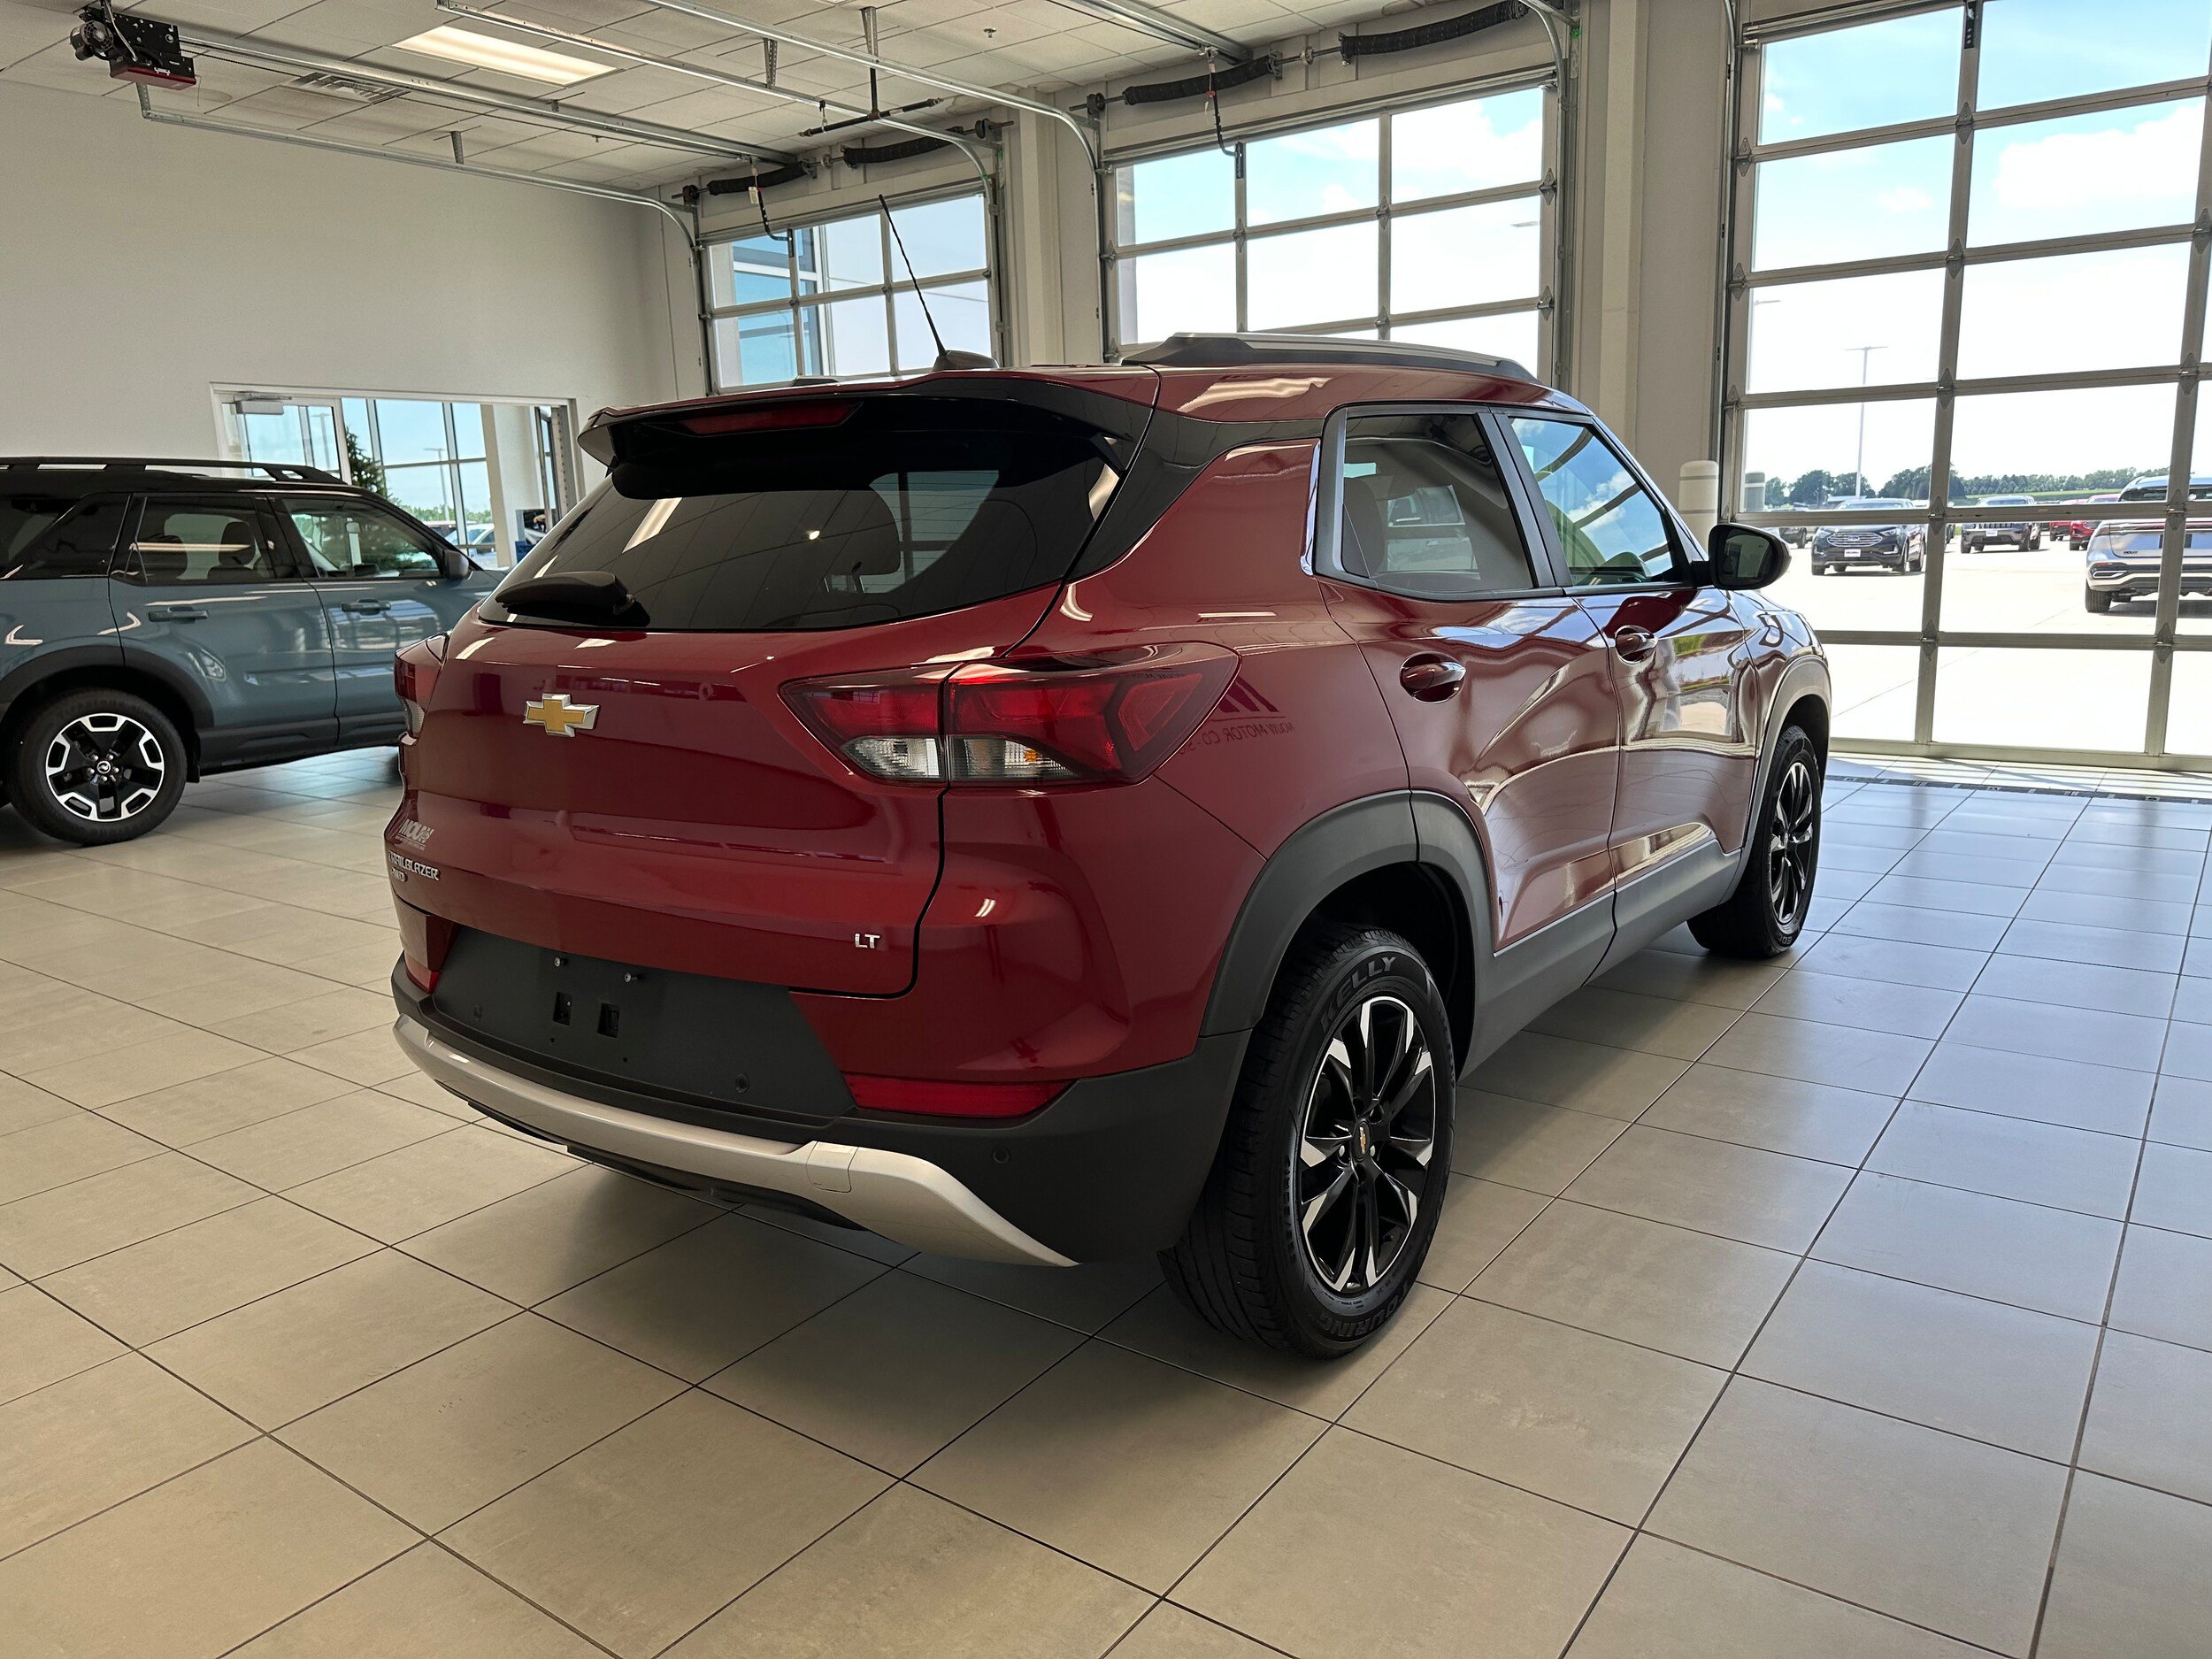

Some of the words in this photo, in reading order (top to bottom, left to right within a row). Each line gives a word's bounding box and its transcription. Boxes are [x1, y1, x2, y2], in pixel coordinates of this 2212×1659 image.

[388, 849, 440, 881] TRAILBLAZER
[855, 933, 880, 949] LT
[1320, 956, 1396, 1033] KELLY
